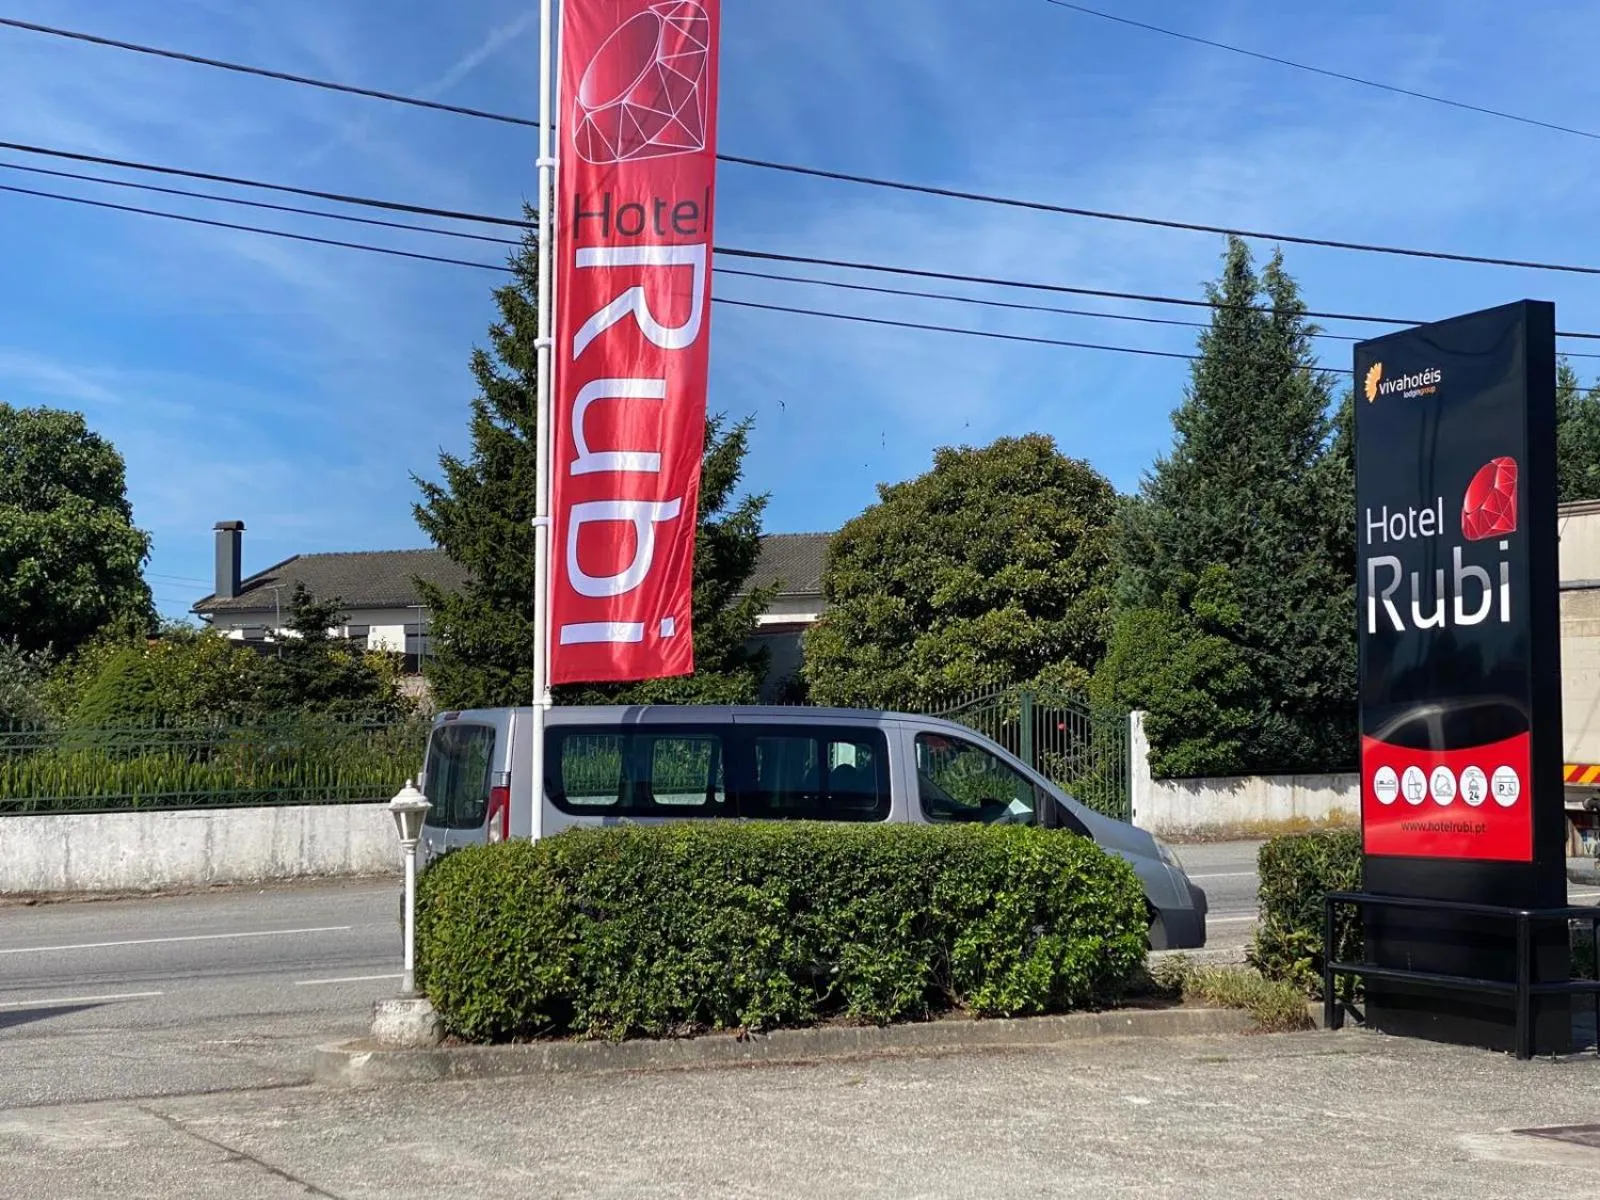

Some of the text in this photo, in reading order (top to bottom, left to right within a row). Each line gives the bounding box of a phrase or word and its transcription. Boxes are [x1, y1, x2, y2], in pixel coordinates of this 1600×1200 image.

[573, 185, 710, 239] Hotel
[1379, 367, 1441, 395] vivahotéis
[560, 243, 707, 645] Rubi
[1366, 496, 1443, 544] Hotel
[1367, 540, 1511, 634] Rubi
[1469, 790, 1480, 800] 24
[1401, 821, 1486, 834] www.hotelrubi.pt
